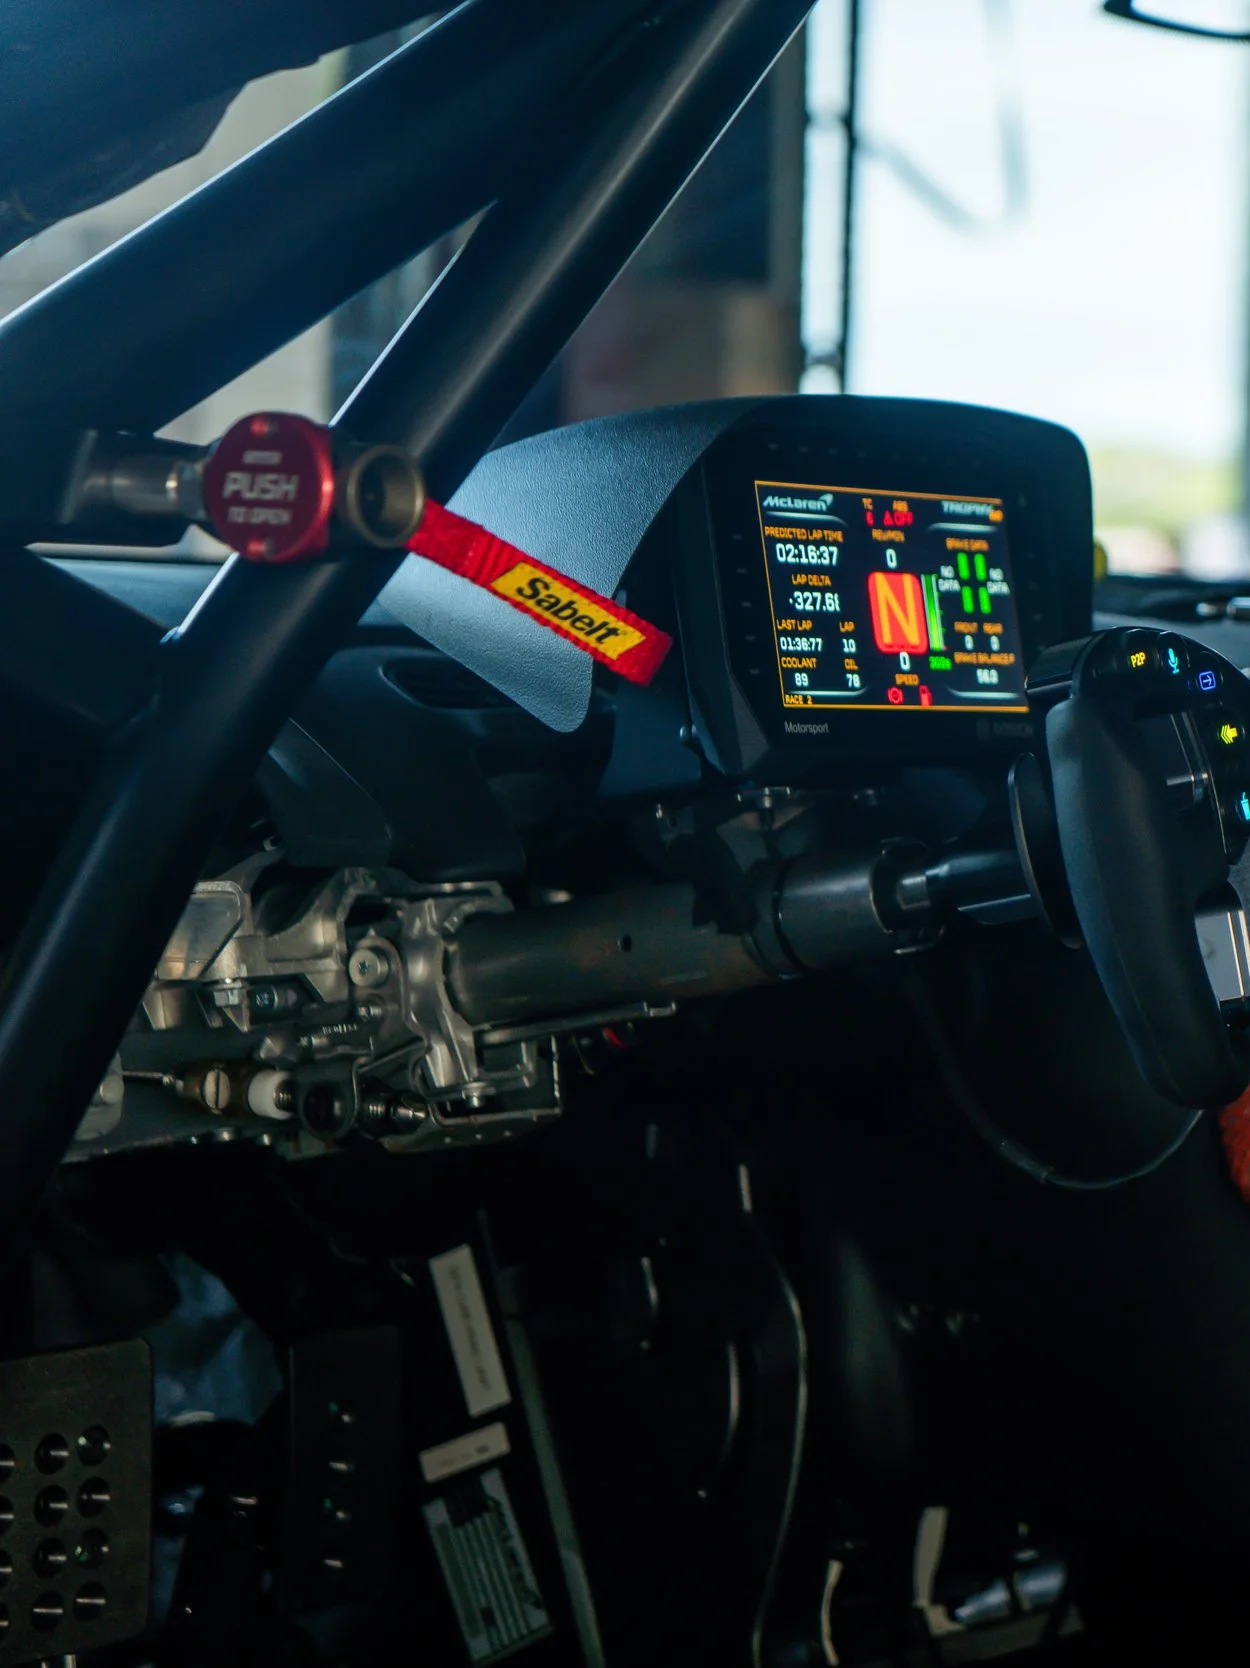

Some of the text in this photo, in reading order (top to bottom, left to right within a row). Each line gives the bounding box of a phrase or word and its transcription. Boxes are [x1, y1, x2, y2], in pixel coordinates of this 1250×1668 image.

[222, 471, 299, 501] PUSH
[762, 495, 827, 511] McLaren
[764, 525, 844, 544] PREDICTED LAP TIME
[775, 543, 839, 567] 02:16:37
[885, 548, 898, 570] 0
[791, 573, 832, 587] LAP DELTA
[515, 576, 620, 645] Sabelt
[875, 572, 920, 646] N
[776, 618, 813, 632] LAST LAP
[839, 621, 855, 633] LAP
[779, 636, 823, 653] 01:36:77
[841, 638, 857, 654] 10
[781, 656, 818, 670] COOLANT
[844, 658, 859, 671] OIL
[899, 651, 911, 671] 0
[1130, 651, 1146, 668] P2P
[794, 672, 809, 687] 89
[784, 694, 813, 705] RACE 2
[784, 721, 829, 735] Motorsport
